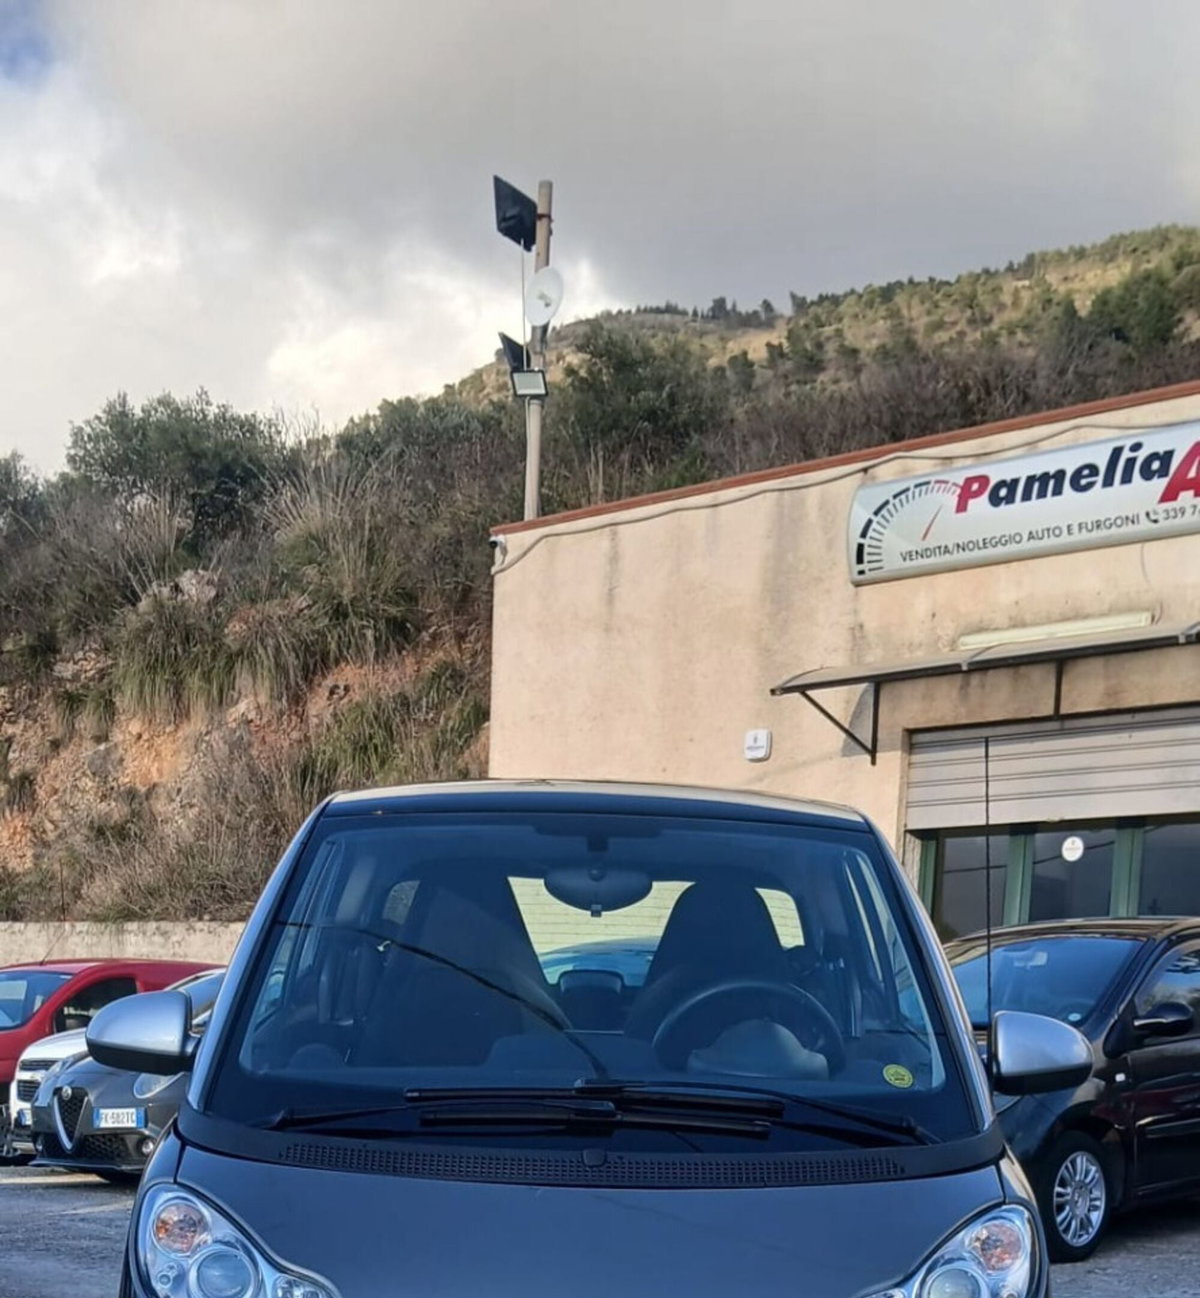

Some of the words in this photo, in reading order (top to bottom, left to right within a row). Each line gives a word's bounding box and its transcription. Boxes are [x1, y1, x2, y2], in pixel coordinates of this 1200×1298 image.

[900, 532, 1023, 562] VENDITA/NOLEGGIO
[1026, 525, 1064, 542] AUTO
[1067, 523, 1075, 537] E
[1078, 513, 1140, 534] FURGONI
[1162, 506, 1186, 520] 339
[1190, 504, 1200, 516] 7
